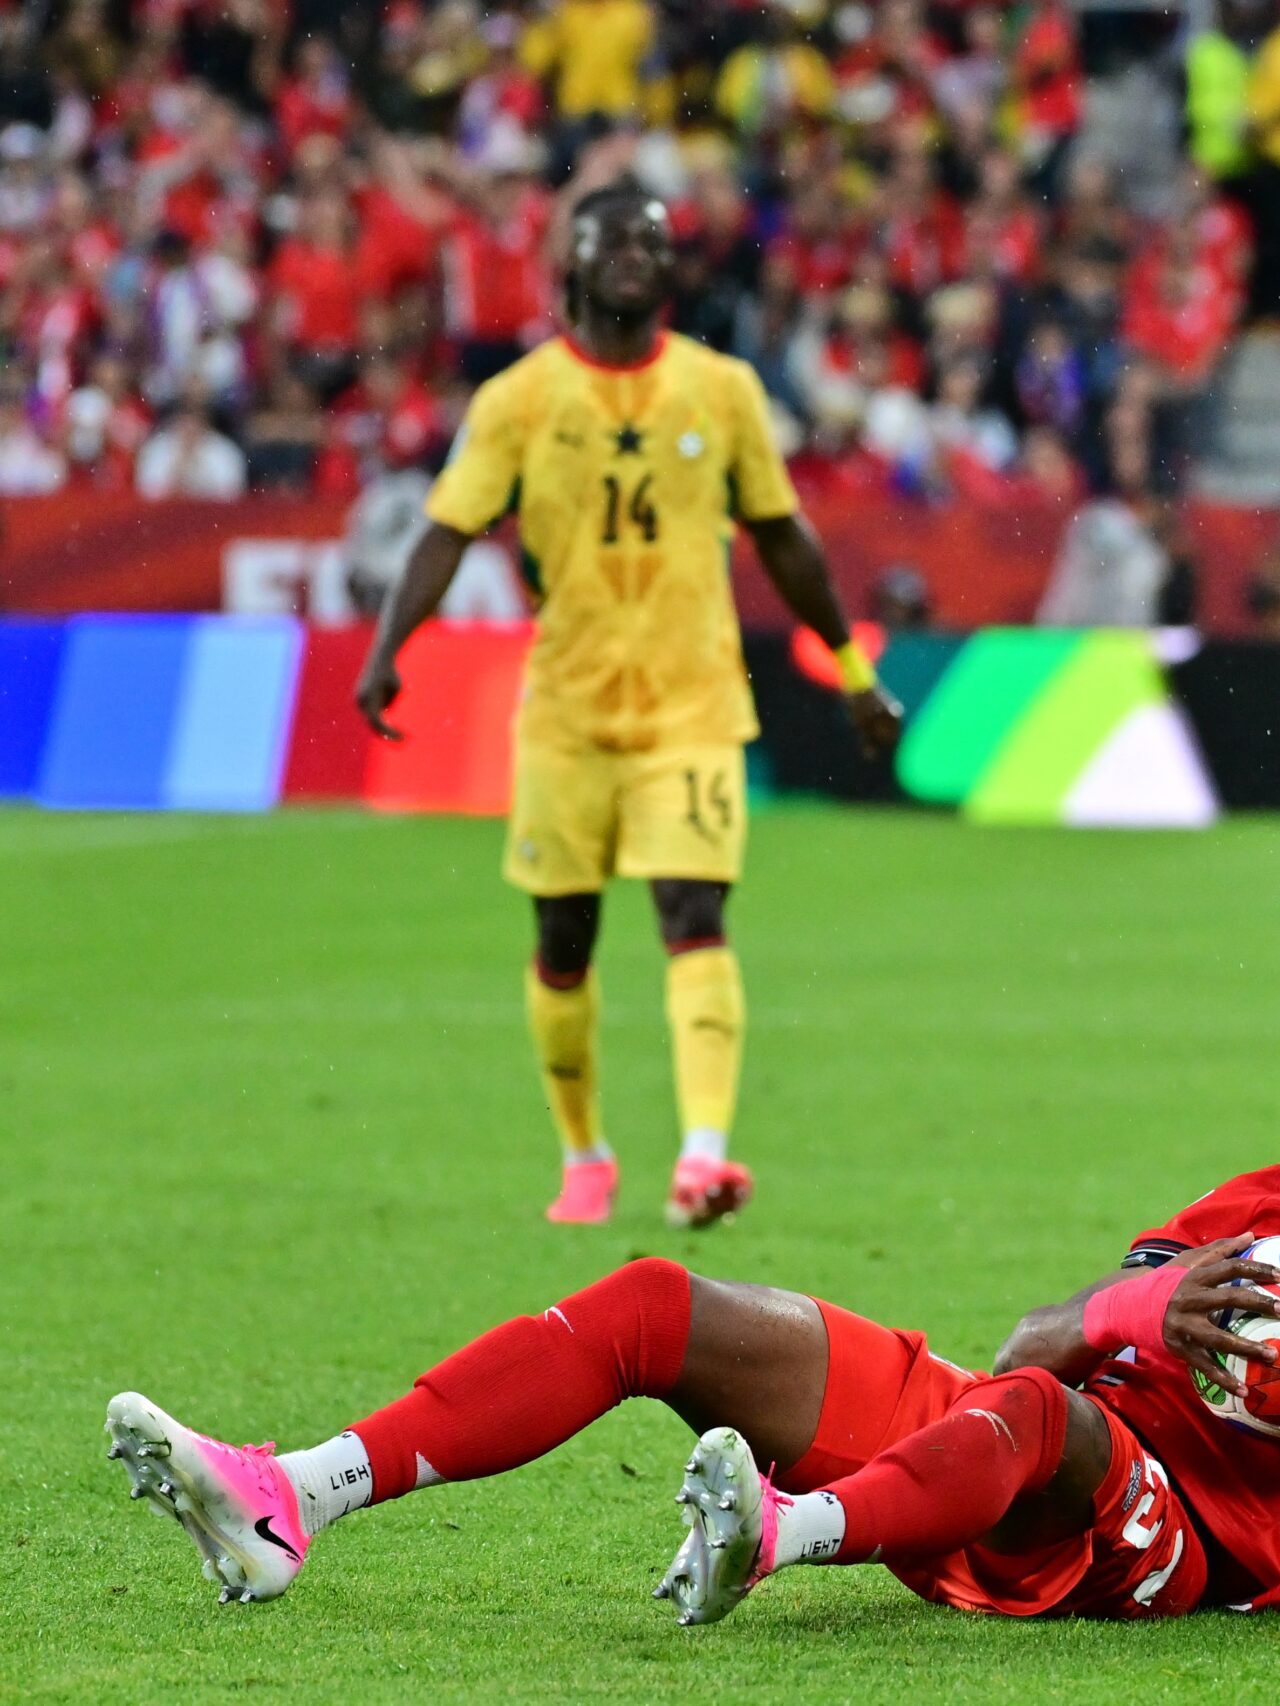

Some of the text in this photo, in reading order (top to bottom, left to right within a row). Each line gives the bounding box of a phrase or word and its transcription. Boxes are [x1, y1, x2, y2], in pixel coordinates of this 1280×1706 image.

[603, 473, 658, 543] 14
[222, 541, 527, 624] FIA
[683, 768, 733, 828] 14
[330, 1464, 370, 1490] LIGH
[801, 1539, 840, 1558] LIGHT
